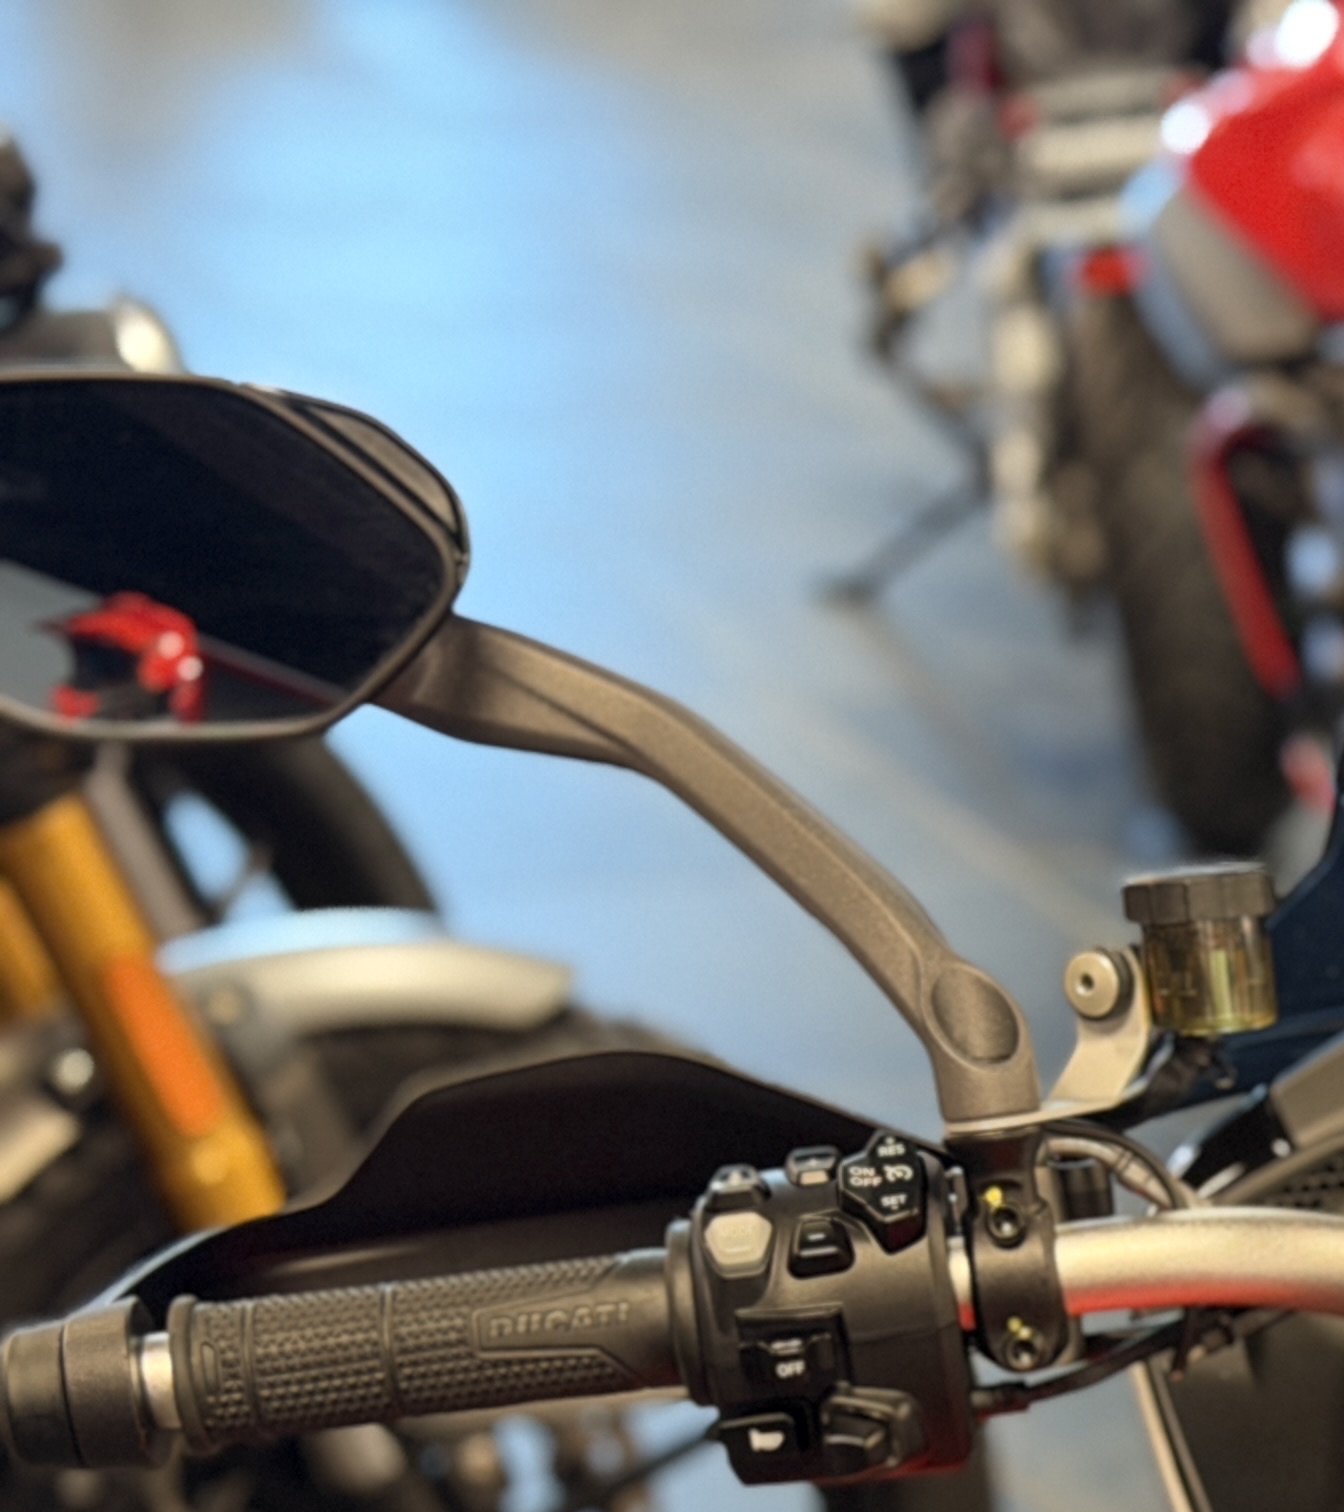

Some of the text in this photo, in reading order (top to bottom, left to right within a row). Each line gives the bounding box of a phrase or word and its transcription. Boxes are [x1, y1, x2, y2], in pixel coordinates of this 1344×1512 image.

[877, 1142, 905, 1157] RES
[848, 1166, 876, 1177] ON
[849, 1175, 882, 1188] OFF
[881, 1193, 907, 1207] SET
[489, 1301, 630, 1338] DUCATI
[775, 1359, 806, 1378] OFF
